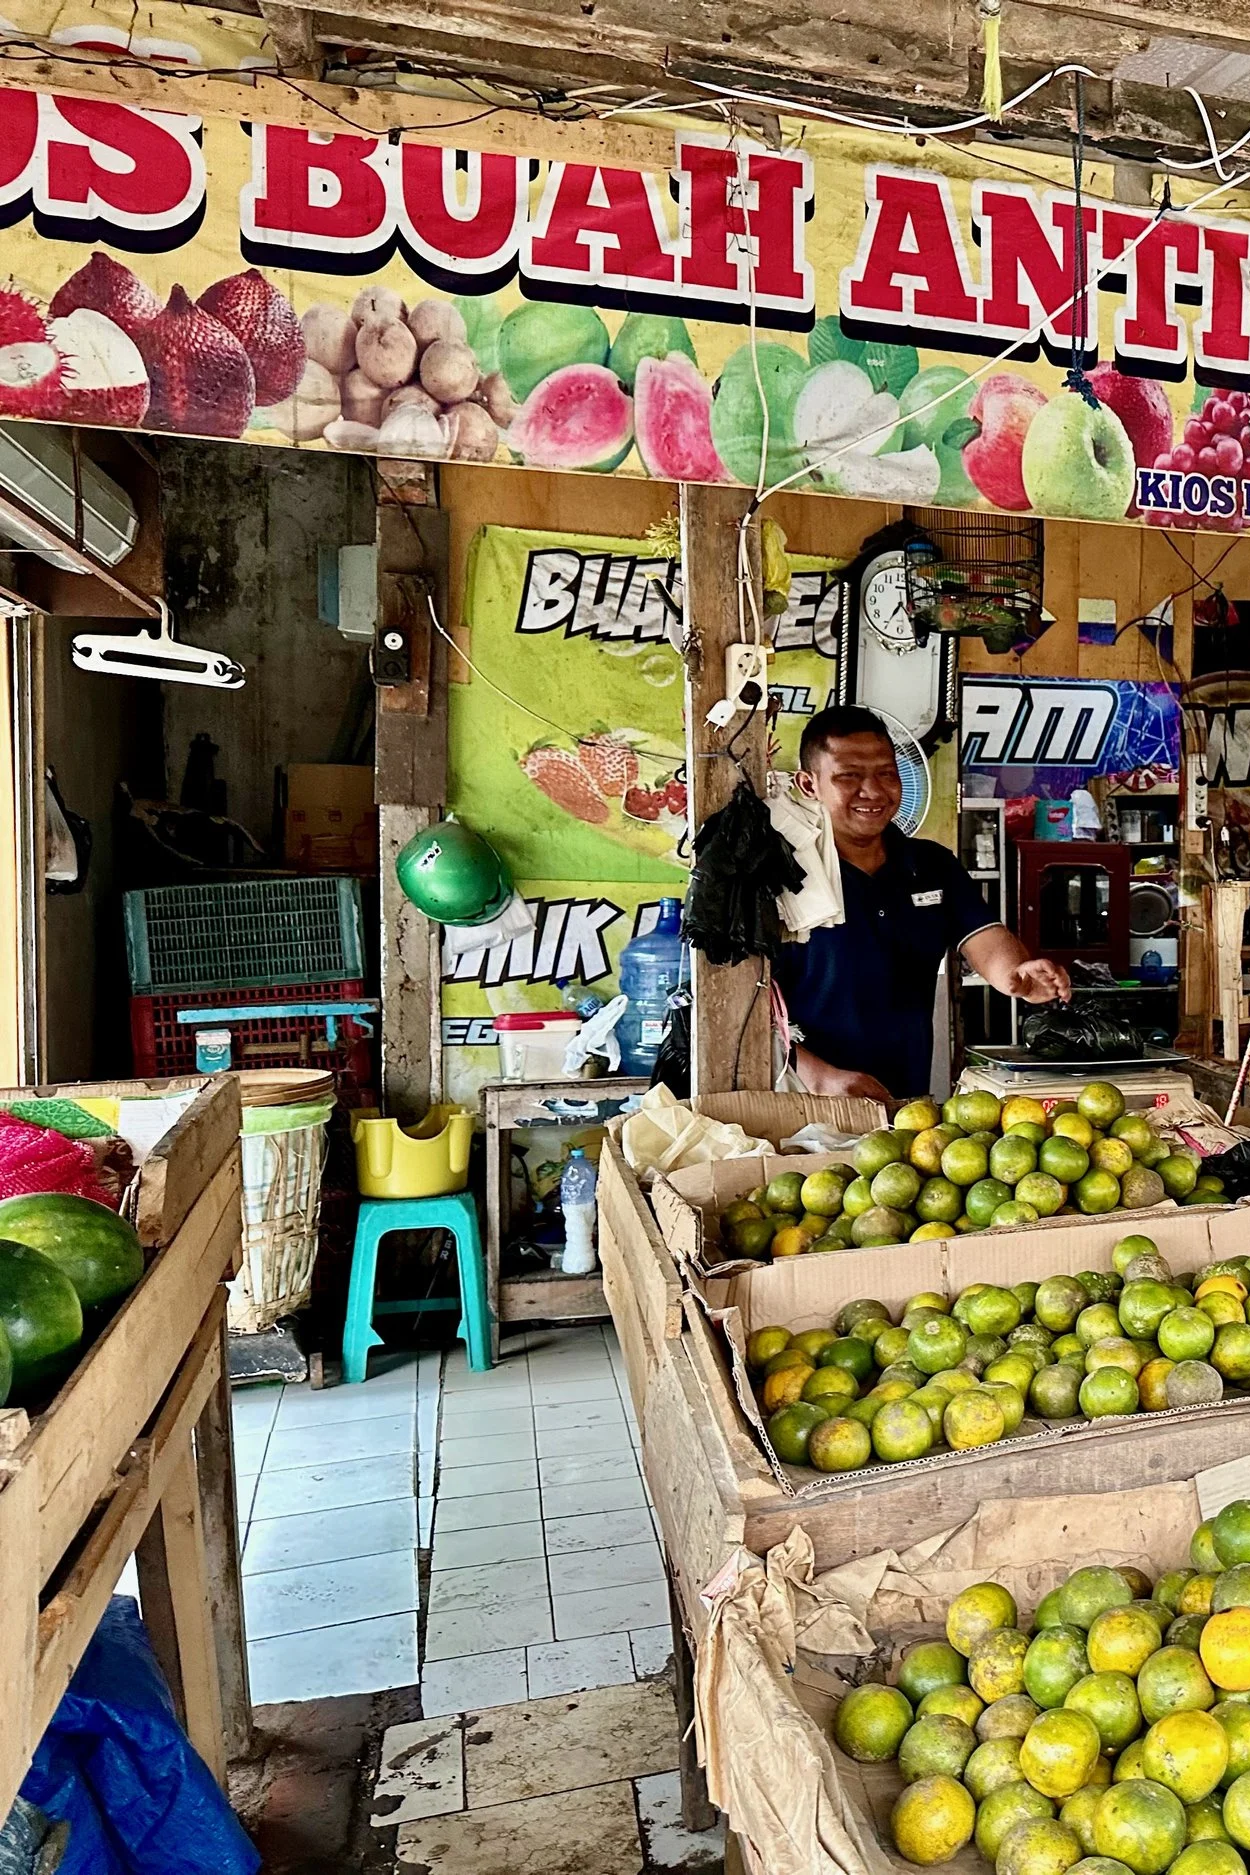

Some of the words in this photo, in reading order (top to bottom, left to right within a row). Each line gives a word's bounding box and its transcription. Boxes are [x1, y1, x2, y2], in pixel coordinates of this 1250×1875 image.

[240, 118, 816, 328] BUAH
[1136, 468, 1236, 516] KIOS
[884, 574, 892, 584] 11
[874, 584, 884, 593] 10
[869, 595, 877, 605] 9
[873, 609, 880, 618] 8
[896, 626, 903, 634] 6
